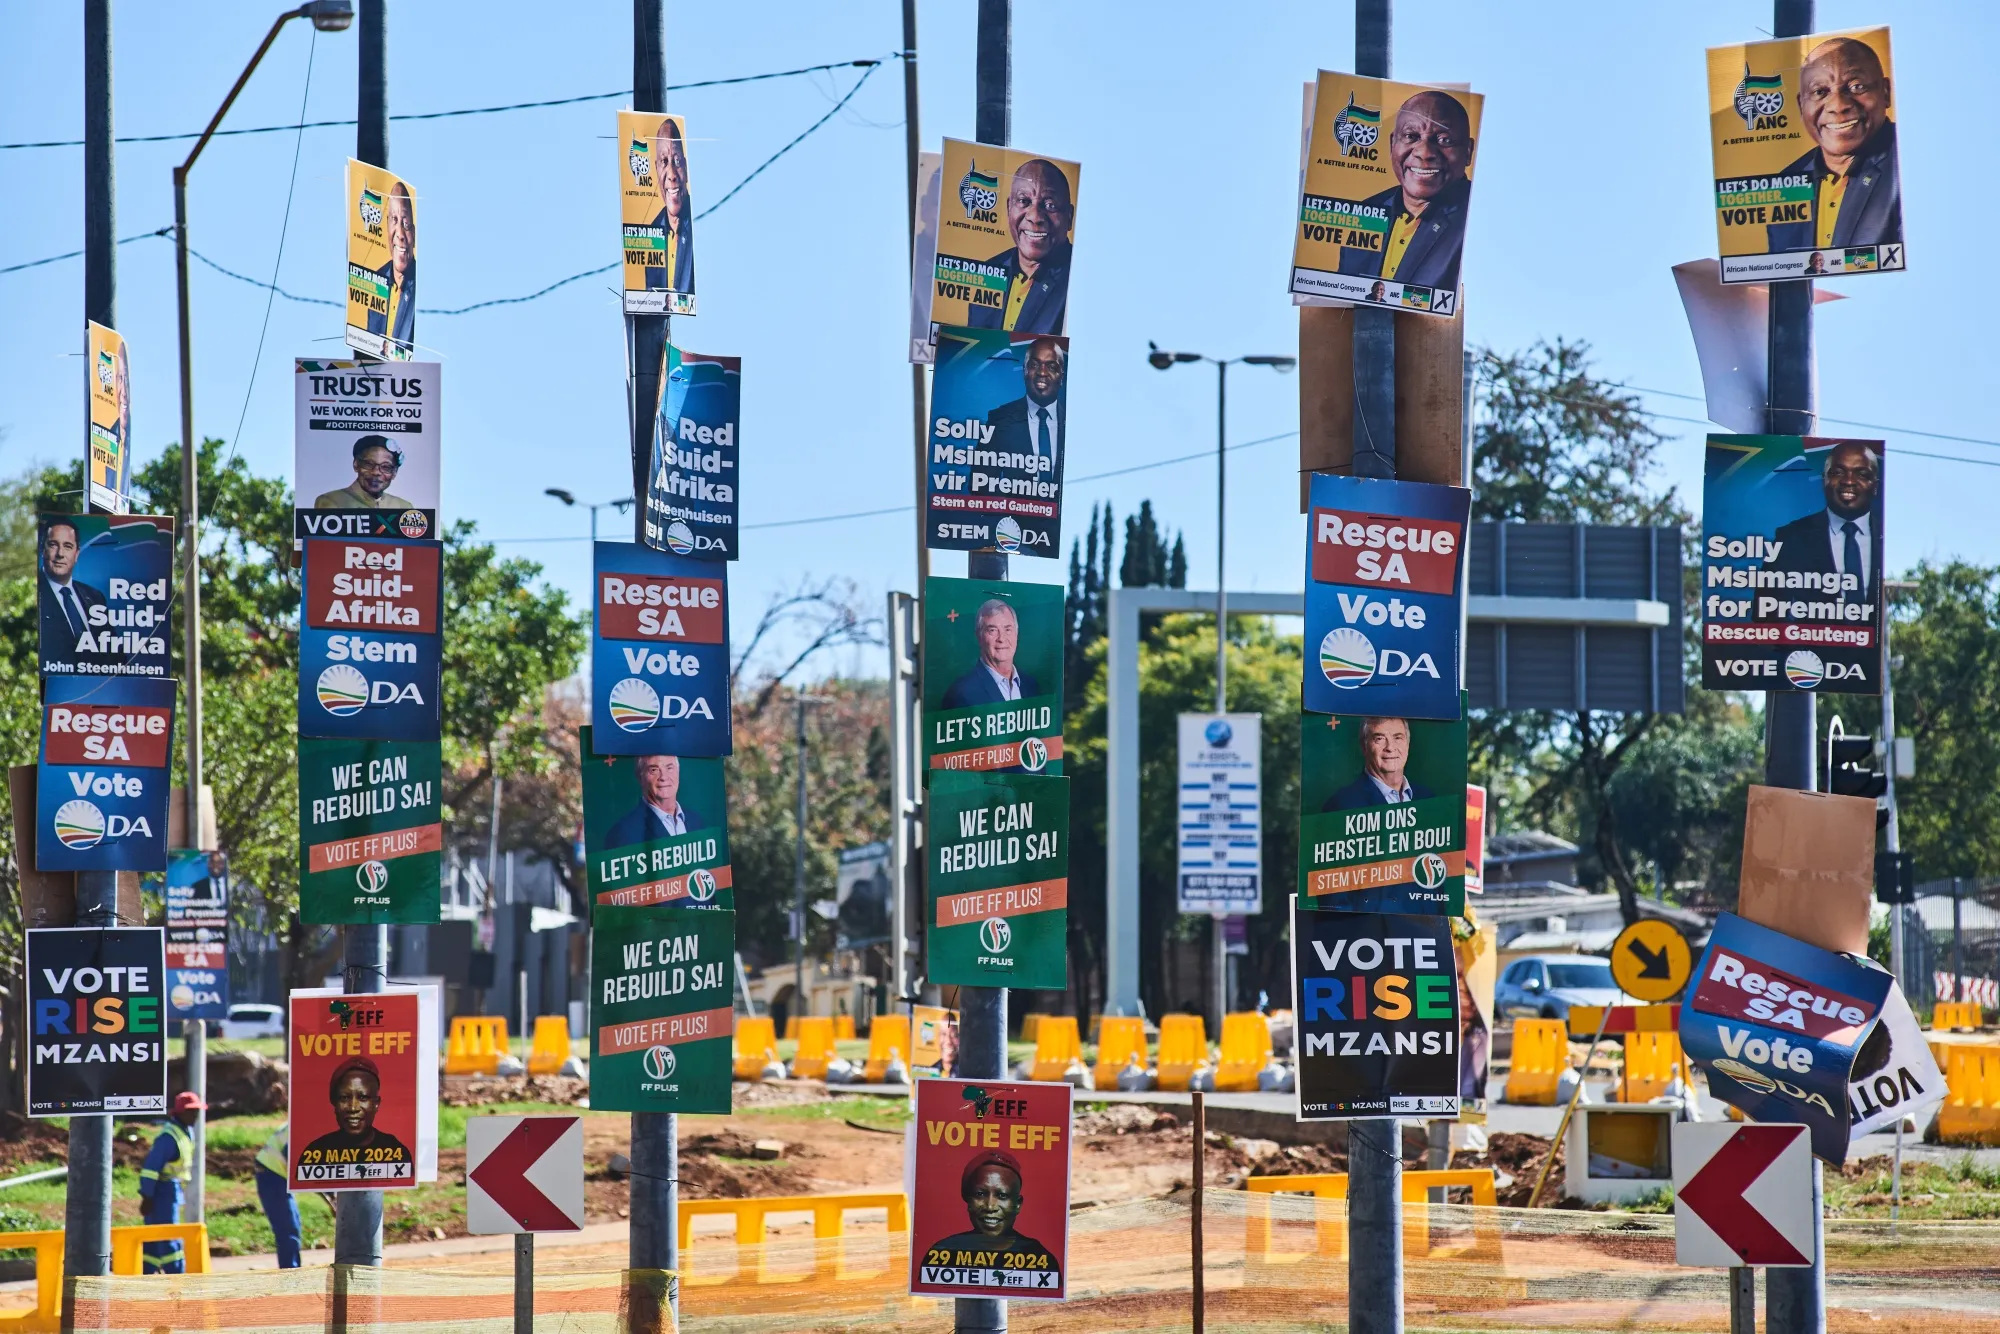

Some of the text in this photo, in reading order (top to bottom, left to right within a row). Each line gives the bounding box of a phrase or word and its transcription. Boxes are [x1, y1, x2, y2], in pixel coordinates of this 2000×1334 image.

[1756, 114, 1788, 131] ANC
[1730, 136, 1754, 145] BETTER
[1756, 135, 1770, 143] LIFE
[1772, 133, 1786, 141] FOR
[1788, 132, 1801, 140] ALL
[1323, 159, 1346, 168] BETTER
[1349, 146, 1379, 161] ANC
[638, 176, 653, 187] ANC
[1719, 175, 1813, 194] LET'S DO MORE,
[1305, 197, 1388, 222] LET'S DO MORE,
[1719, 190, 1786, 206] TOGETHER.
[973, 209, 998, 224] ANC
[1304, 209, 1362, 229] TOGETHER.
[1721, 203, 1808, 226] VOTE ANC
[369, 224, 383, 237] ANC
[624, 226, 665, 240] LET'S DO MORE,
[1303, 223, 1380, 250] VOTE ANC
[625, 250, 664, 266] VOTE ANC
[1726, 258, 1842, 273] African National Congress ANC
[350, 288, 385, 311] VOTE ANC
[937, 282, 1001, 307] VOTE ANC
[1296, 276, 1399, 299] African National Congress ANC
[310, 376, 422, 398] TRUST US
[311, 405, 421, 418] WE WORK FOR YOU
[325, 422, 406, 431] #DOITFORSHENGE
[679, 417, 733, 446] Red
[935, 417, 995, 444] Solly
[93, 446, 105, 463] VOTE
[934, 444, 1050, 473] Msimanga
[933, 471, 1059, 499] vir Premier
[932, 495, 1053, 516] Stem en red Gauteng
[303, 515, 370, 534] VOTE
[937, 523, 1051, 547] STEM DA
[1317, 513, 1455, 555] Rescue
[345, 546, 403, 571] Red
[1707, 535, 1783, 563] Solly
[1355, 551, 1411, 584] SA
[1707, 565, 1858, 594] Msimanga
[110, 578, 166, 600] Red
[332, 573, 413, 598] Suid-
[603, 577, 720, 609] Rescue
[88, 605, 165, 627] Suid-
[325, 600, 420, 626] Afrika
[1337, 592, 1426, 630] Vote
[1707, 595, 1874, 621] for Premier
[75, 631, 165, 654] Afrika
[1708, 624, 1869, 646] Rescue Gauteng
[325, 635, 417, 664] Stem
[623, 647, 700, 677] Vote
[43, 661, 164, 675] John Steenhuisen
[1378, 648, 1441, 679] DA
[1715, 659, 1866, 681] VOTE DA
[370, 681, 424, 705] DA
[662, 695, 714, 720] DA
[51, 708, 165, 735] Rescue
[83, 736, 130, 760] SA
[68, 772, 142, 797] Vote
[332, 755, 407, 791] WE CAN
[312, 781, 431, 825] REBUILD SA!
[107, 815, 152, 837] DA
[959, 802, 1033, 838] WE CAN
[1345, 806, 1417, 836] KOM ONS
[325, 832, 417, 863] VOTE FF PLUS!
[940, 831, 1058, 874] REBUILD SA!
[1314, 826, 1450, 864] HERSTEL EN BOU!
[1317, 864, 1402, 890] STEM VF PLUS!
[952, 886, 1042, 918] VOTE FF PLUS!
[1424, 894, 1449, 902] PLUS
[183, 955, 209, 967] SA
[1311, 938, 1439, 971] VOTE
[43, 967, 149, 994] VOTE
[176, 971, 216, 985] Vote
[603, 962, 723, 1005] REBUILD SA!
[194, 992, 221, 1004] DA
[1303, 975, 1453, 1022] RISE
[36, 997, 159, 1035] RISE
[1743, 998, 1805, 1030] SA
[614, 1015, 708, 1047] VOTE FF PLUS!
[36, 1043, 159, 1065] MZANSI
[299, 1032, 411, 1056] VOTE EFF
[1305, 1031, 1453, 1057] MZANSI
[1717, 1025, 1814, 1074] Vote
[926, 1120, 1061, 1150] VOTE EFF
[303, 1148, 403, 1164] 29 MAY 2024
[928, 1250, 1048, 1269] 29 MAY 2024
